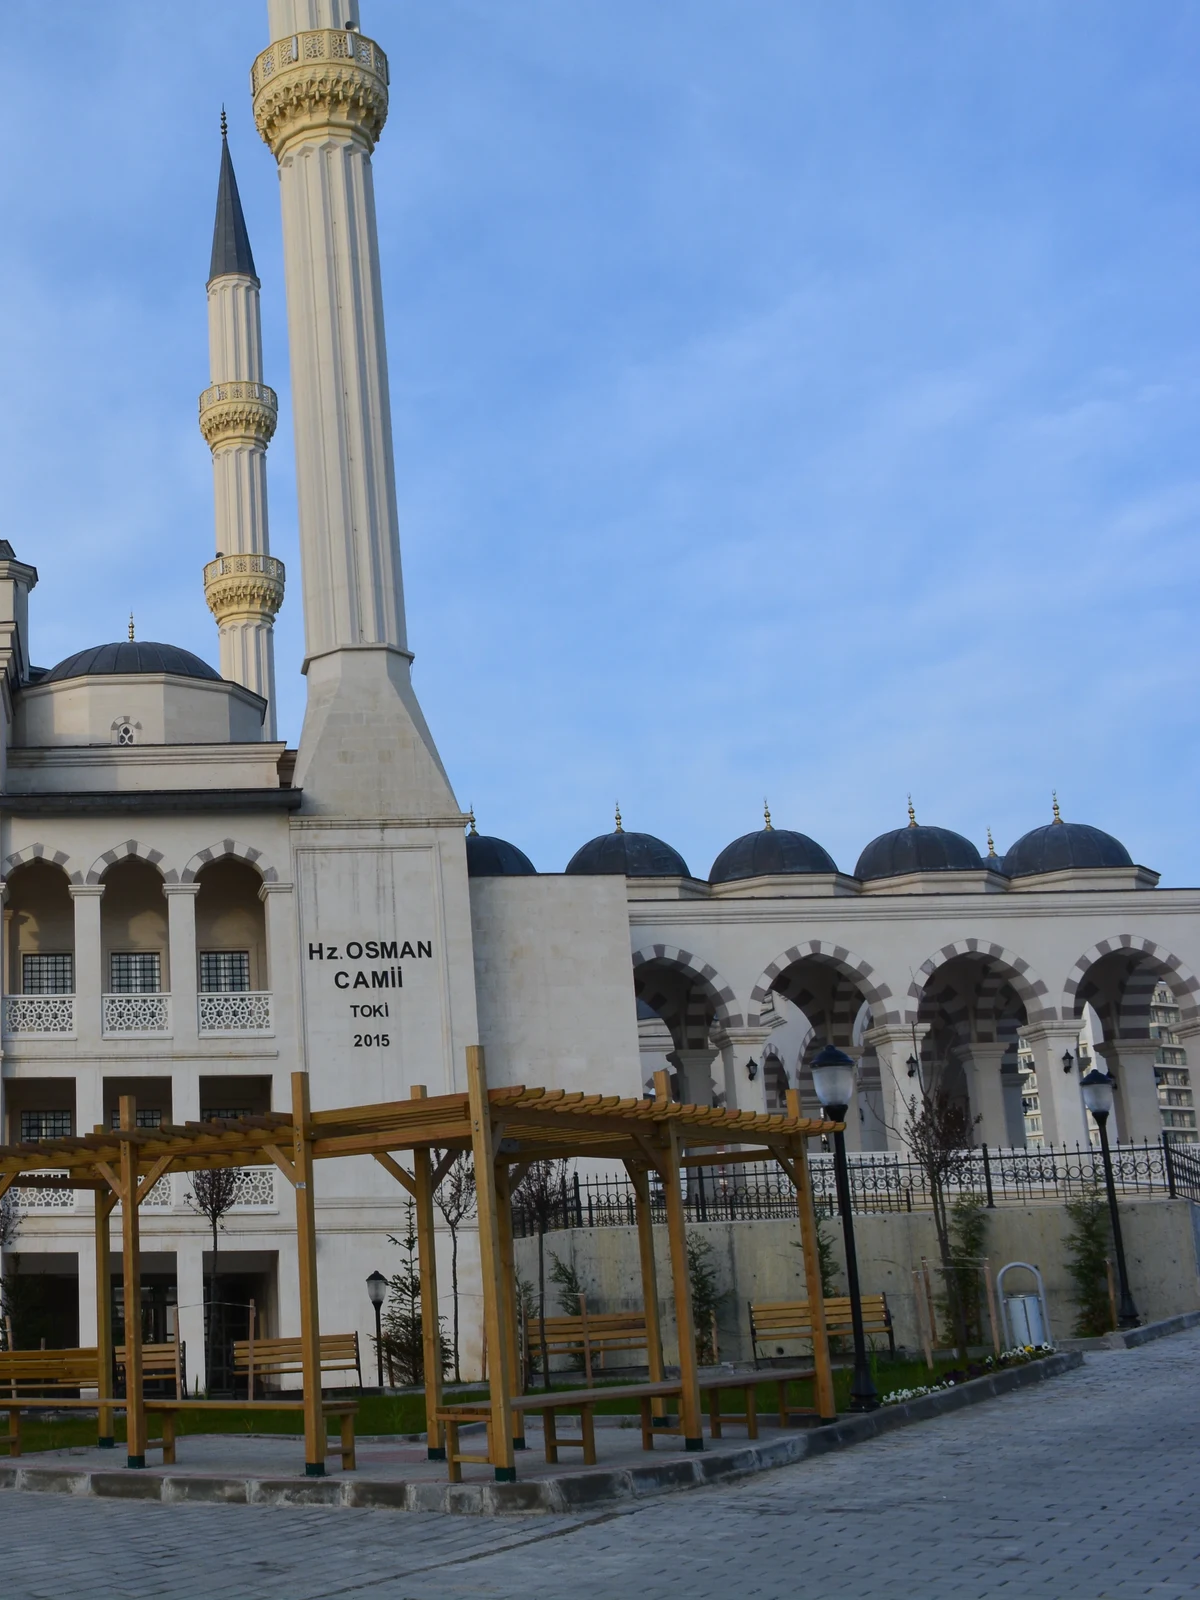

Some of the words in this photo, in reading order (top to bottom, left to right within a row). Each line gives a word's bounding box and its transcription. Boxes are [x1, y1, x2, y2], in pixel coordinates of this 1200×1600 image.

[346, 940, 433, 960] OSMAN
[334, 966, 403, 989] CAMİİ
[350, 1002, 389, 1018] TOKİ
[353, 1033, 390, 1047] 2015
